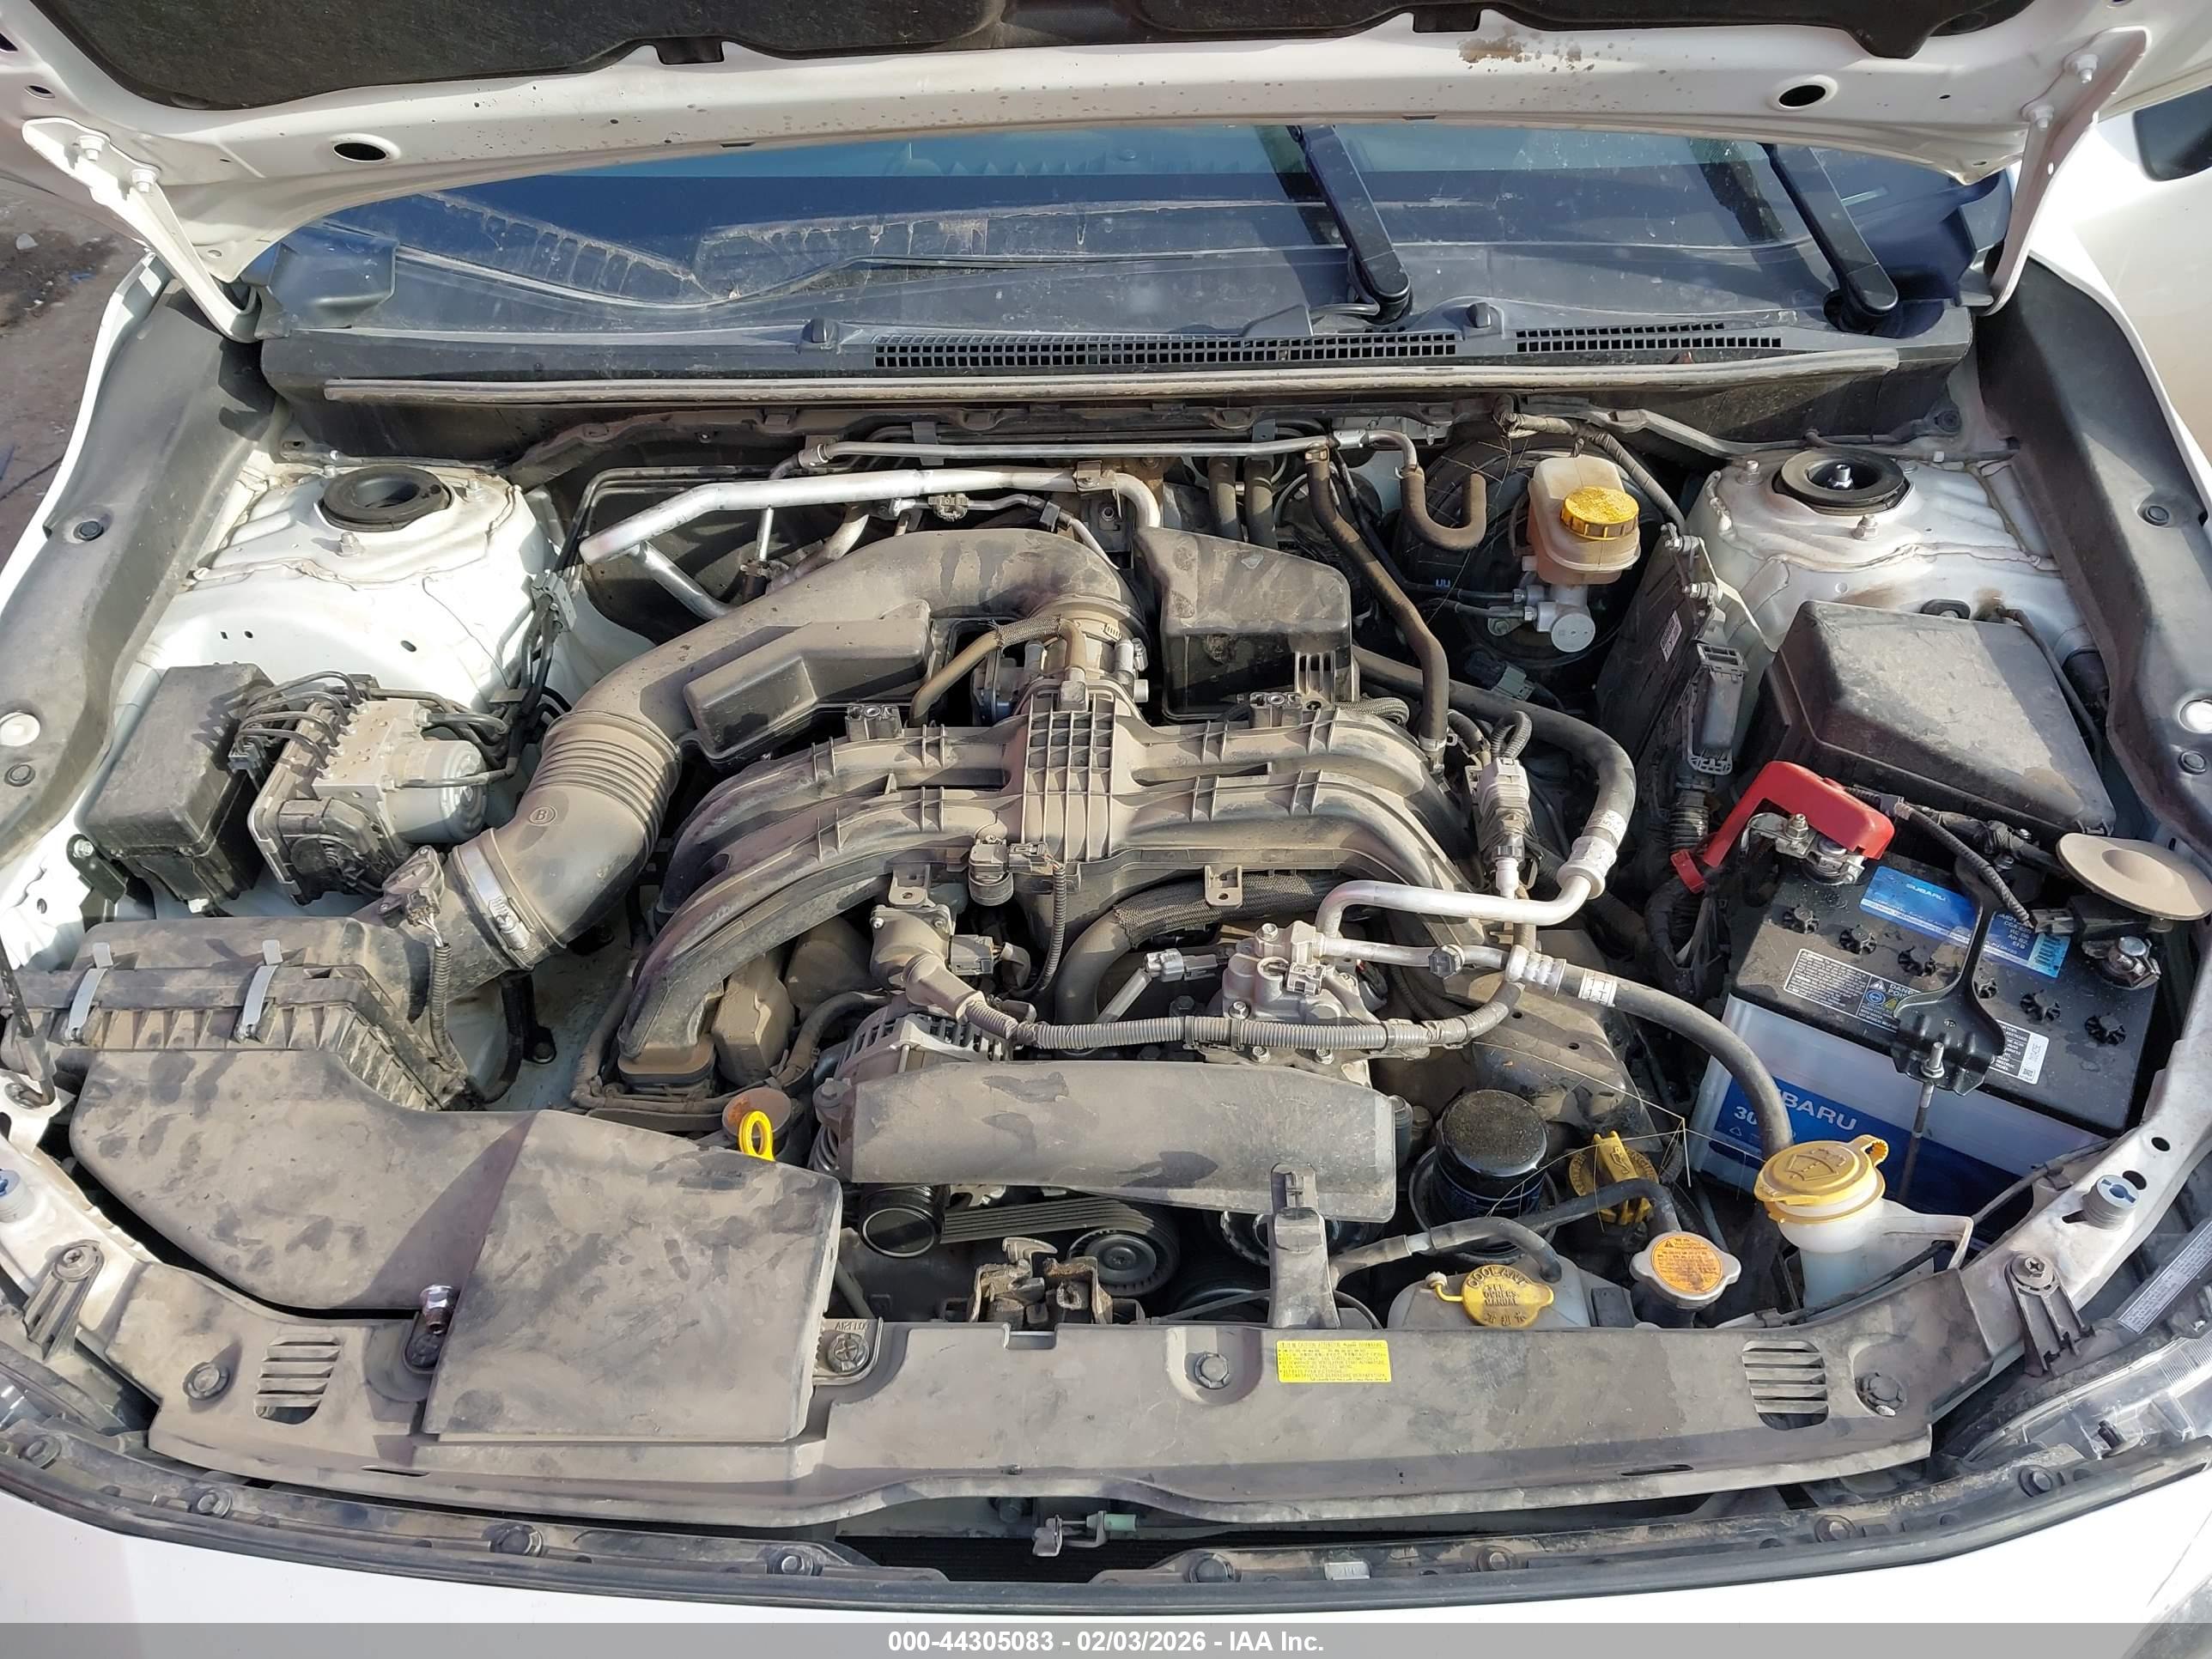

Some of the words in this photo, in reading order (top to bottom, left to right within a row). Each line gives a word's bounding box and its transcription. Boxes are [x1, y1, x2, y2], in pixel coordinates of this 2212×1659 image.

[1905, 883, 1947, 902] SUBARU
[1889, 983, 1916, 995] DANG
[1778, 1089, 1857, 1130] BARU
[1467, 1266, 1528, 1289] COOLANT
[1484, 1297, 1519, 1306] MANUAL
